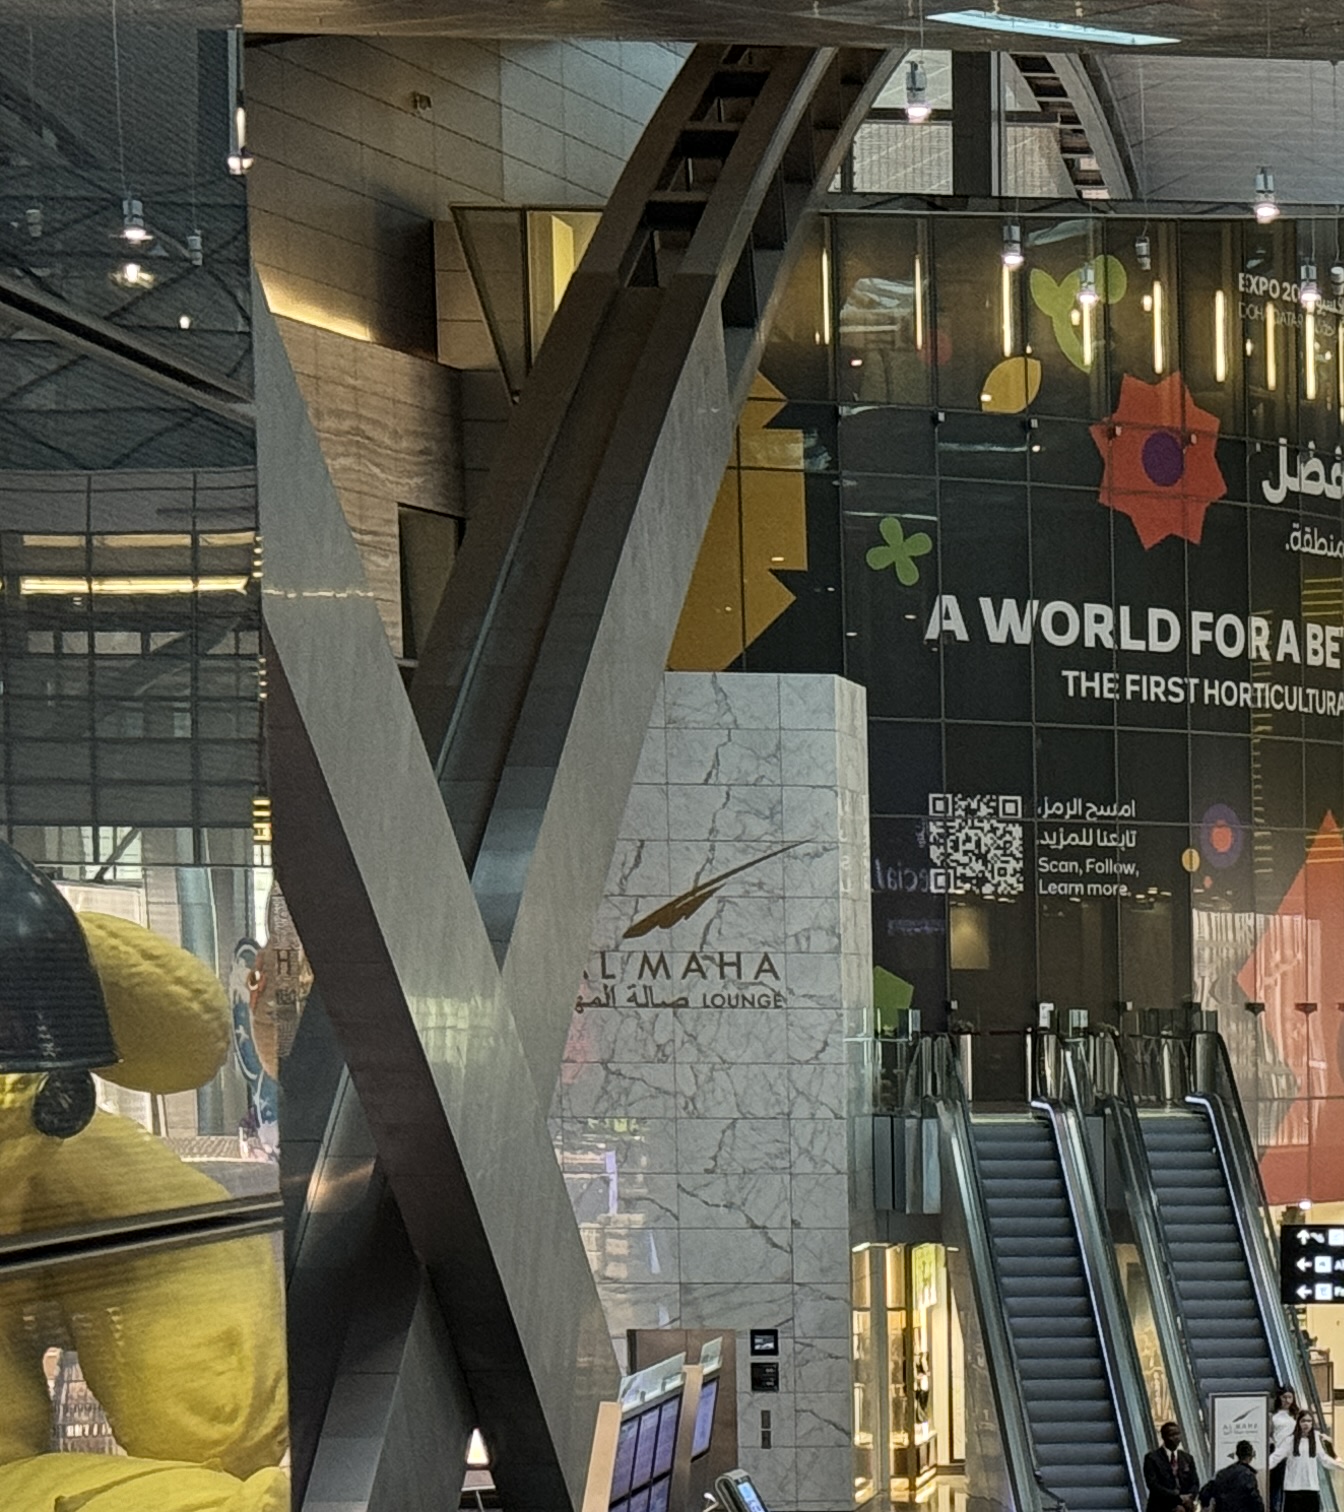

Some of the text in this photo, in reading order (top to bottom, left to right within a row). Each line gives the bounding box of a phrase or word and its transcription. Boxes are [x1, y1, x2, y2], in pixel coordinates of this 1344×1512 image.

[923, 594, 970, 643] A
[978, 596, 1182, 653] WORLD
[1191, 610, 1272, 662] FOR
[1276, 618, 1302, 664] A
[1061, 669, 1120, 701] THE
[1125, 672, 1200, 706] FIRST
[1085, 799, 1136, 821] امسح
[1096, 829, 1138, 851] تابعنا
[1038, 856, 1140, 878] Scan, Follow,
[1038, 878, 1132, 897] Learn more.
[637, 950, 782, 980] MAHA
[626, 983, 690, 1009] صالة
[702, 993, 784, 1010] LOUNGE
